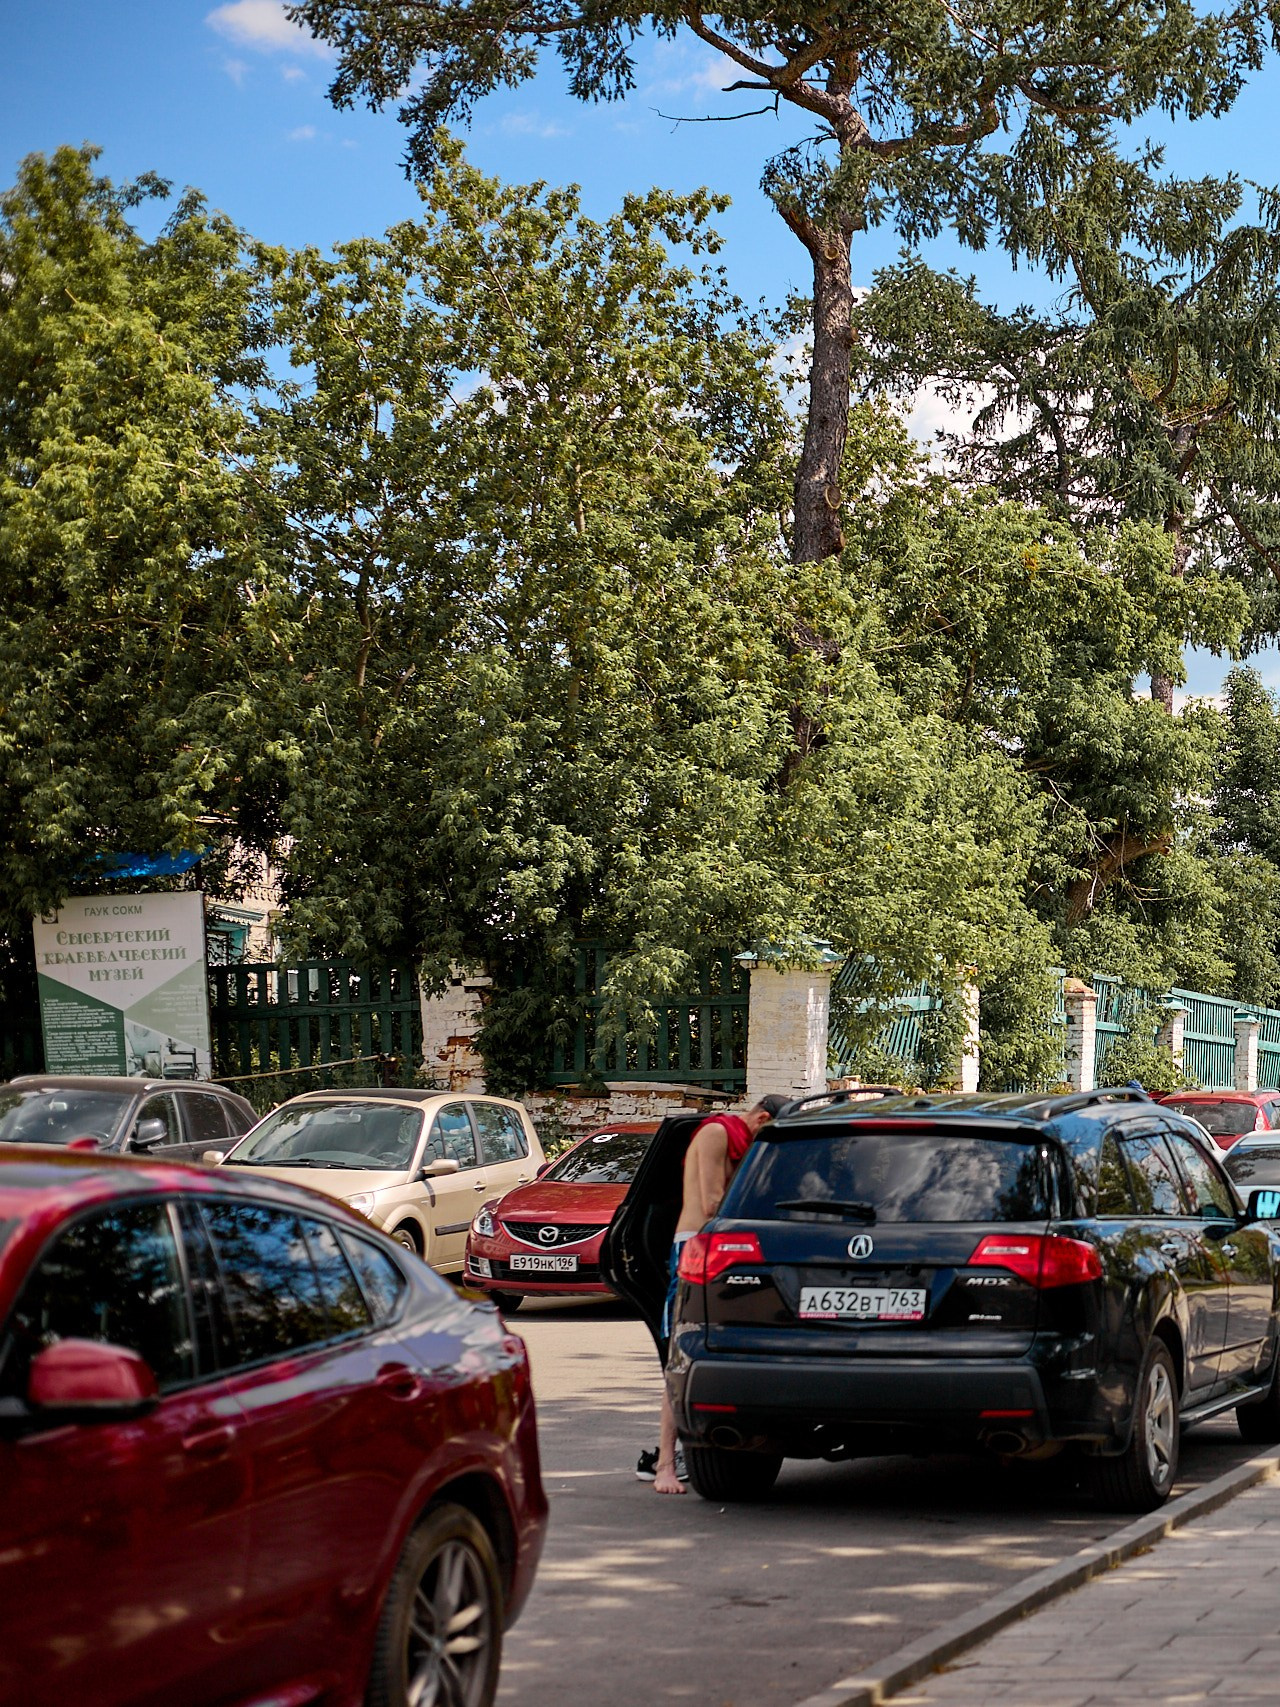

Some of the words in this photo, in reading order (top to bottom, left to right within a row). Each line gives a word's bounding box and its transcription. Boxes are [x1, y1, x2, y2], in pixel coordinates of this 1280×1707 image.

[84, 907, 109, 917] ГАУК
[112, 905, 142, 916] СОКМ
[44, 946, 188, 965] КРАЕВЕДЧЕСКИЙ
[89, 966, 144, 982] МУЗЕЙ
[513, 1257, 554, 1270] Е919НК
[557, 1257, 573, 1267] 196
[726, 1275, 761, 1285] ACURA
[966, 1277, 1011, 1286] MDX
[806, 1291, 885, 1312] А632ВТ
[890, 1291, 920, 1307] 763
